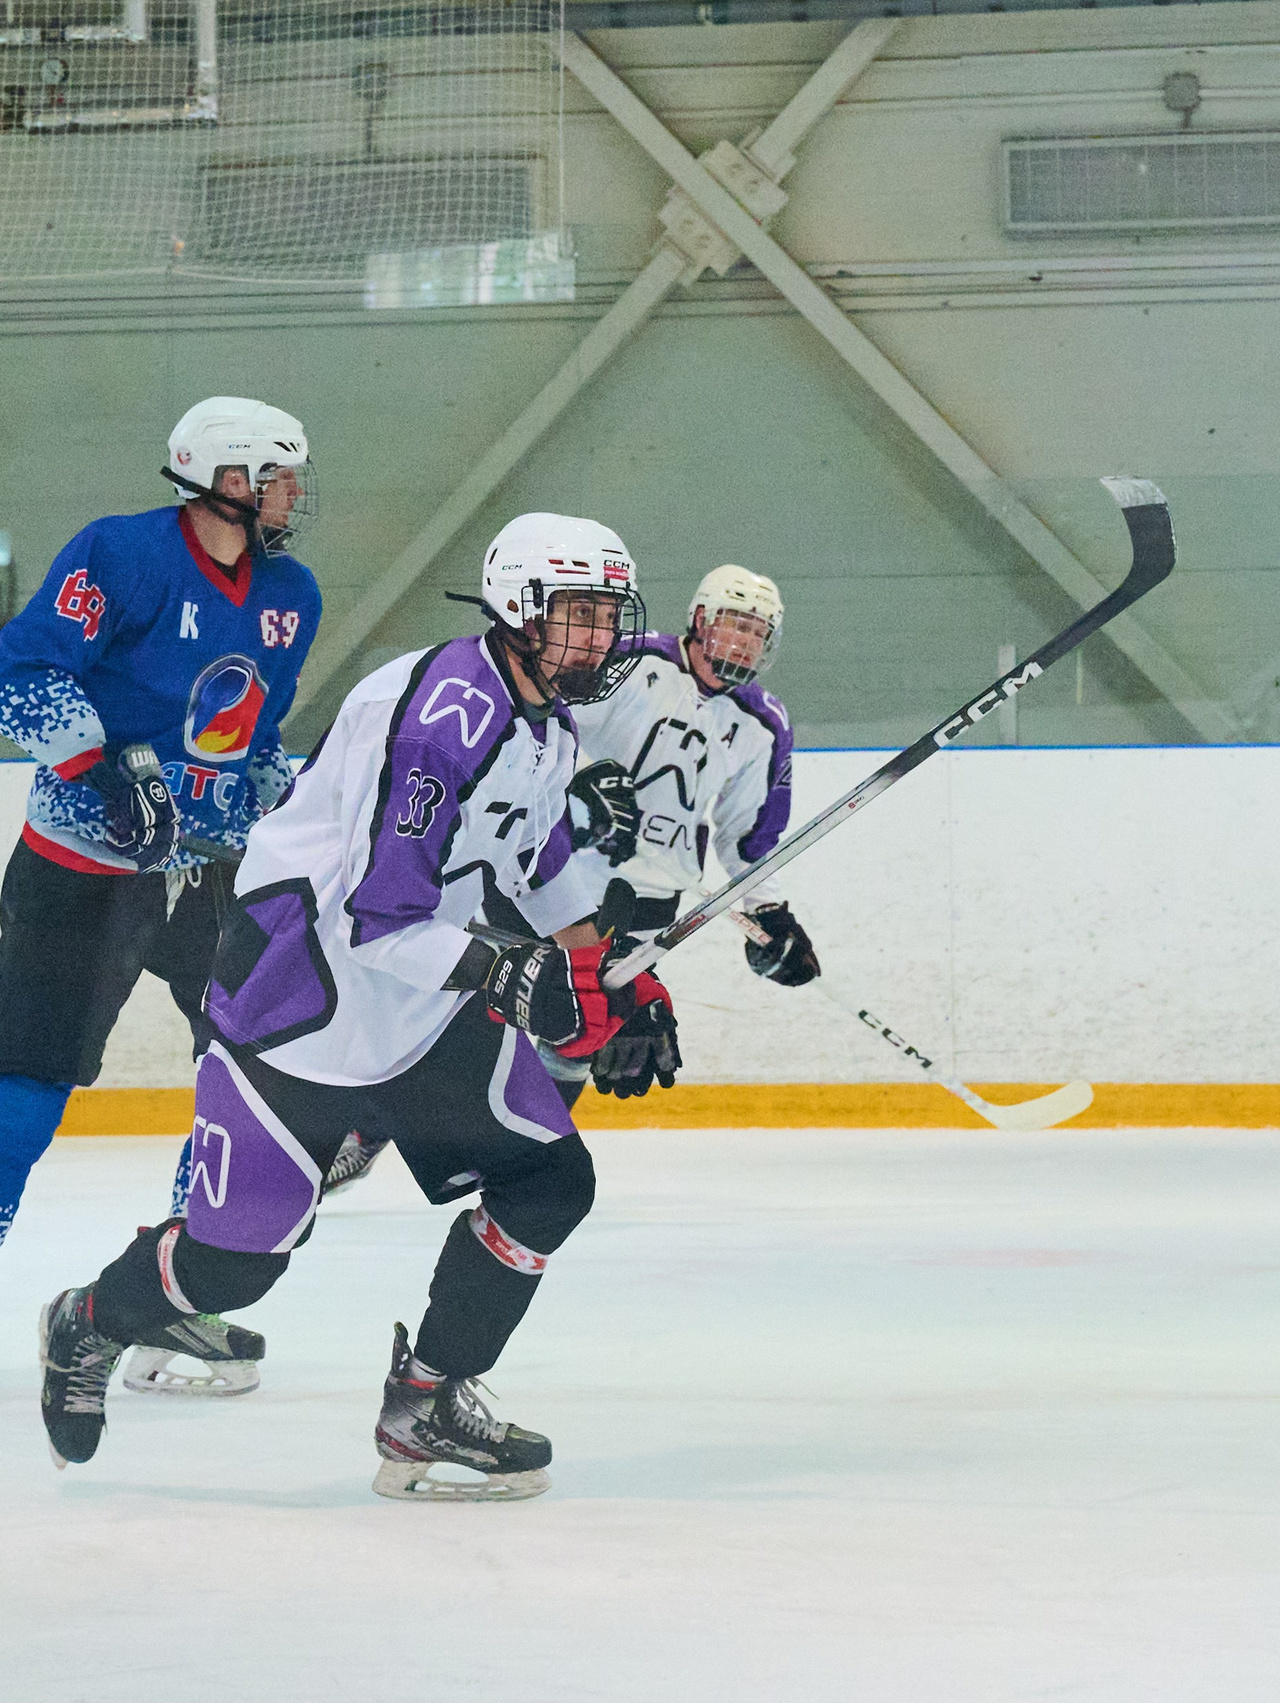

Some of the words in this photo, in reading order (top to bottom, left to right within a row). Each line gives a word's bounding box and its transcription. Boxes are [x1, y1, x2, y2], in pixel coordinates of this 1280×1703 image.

[603, 560, 631, 570] CCM
[260, 608, 300, 649] 69
[933, 661, 1045, 748] CCM
[858, 1009, 933, 1069] CCM
